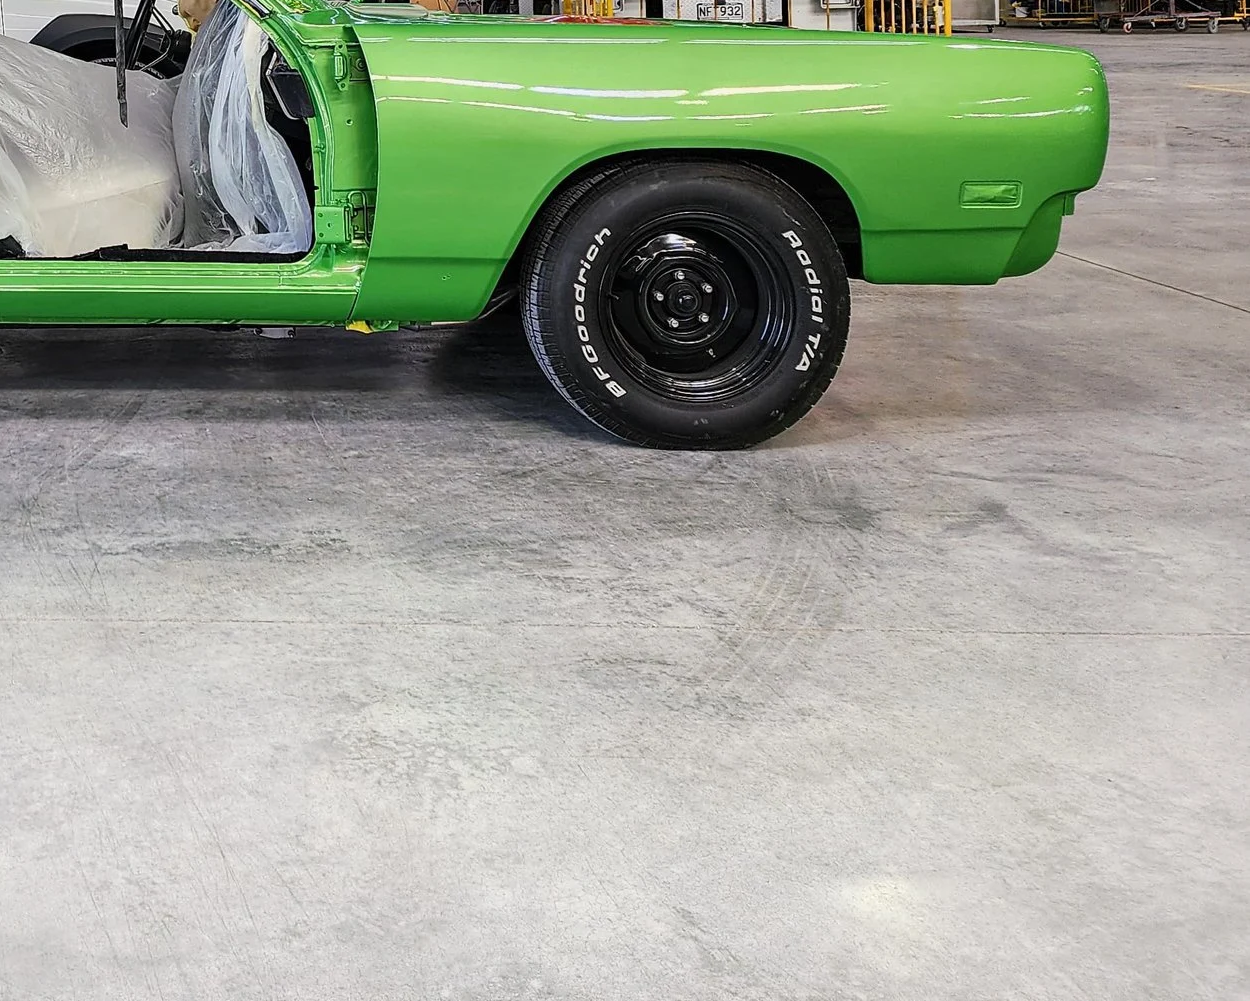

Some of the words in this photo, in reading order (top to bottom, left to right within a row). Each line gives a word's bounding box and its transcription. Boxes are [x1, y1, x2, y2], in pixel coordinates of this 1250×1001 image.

[573, 227, 627, 398] BFGoodrich
[781, 230, 823, 324] Radial
[795, 333, 821, 372] T/A
